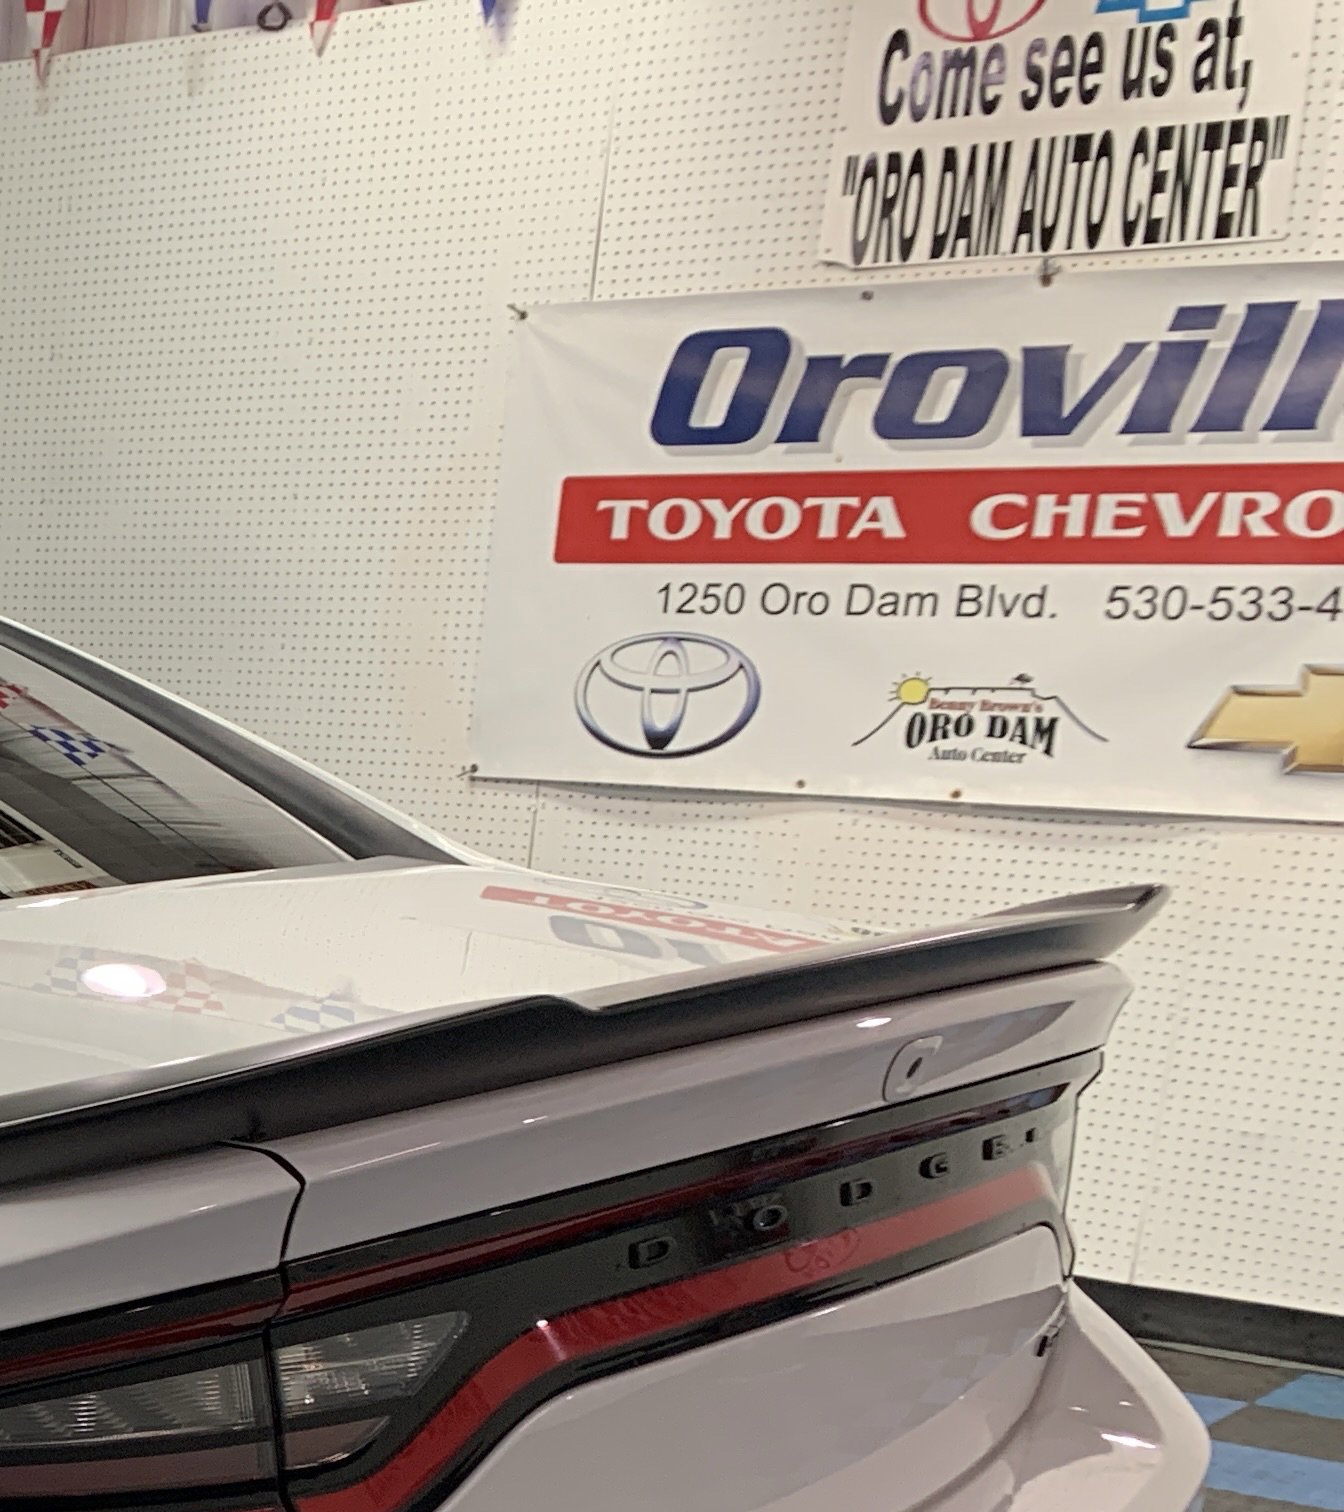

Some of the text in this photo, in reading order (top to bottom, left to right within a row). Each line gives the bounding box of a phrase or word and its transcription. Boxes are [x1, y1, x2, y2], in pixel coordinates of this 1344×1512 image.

[878, 28, 1007, 126] Come
[1020, 31, 1105, 111] see
[1122, 22, 1178, 100] us
[842, 114, 1290, 266] "ORO DAM AUTO CENTER"
[596, 488, 1344, 541] TOYOTA CHEVRO
[657, 582, 1343, 623] 1250 Oro Dam Blvd. 530-533-4
[905, 711, 1060, 758] ORO DAM
[928, 746, 1027, 764] Auto Center
